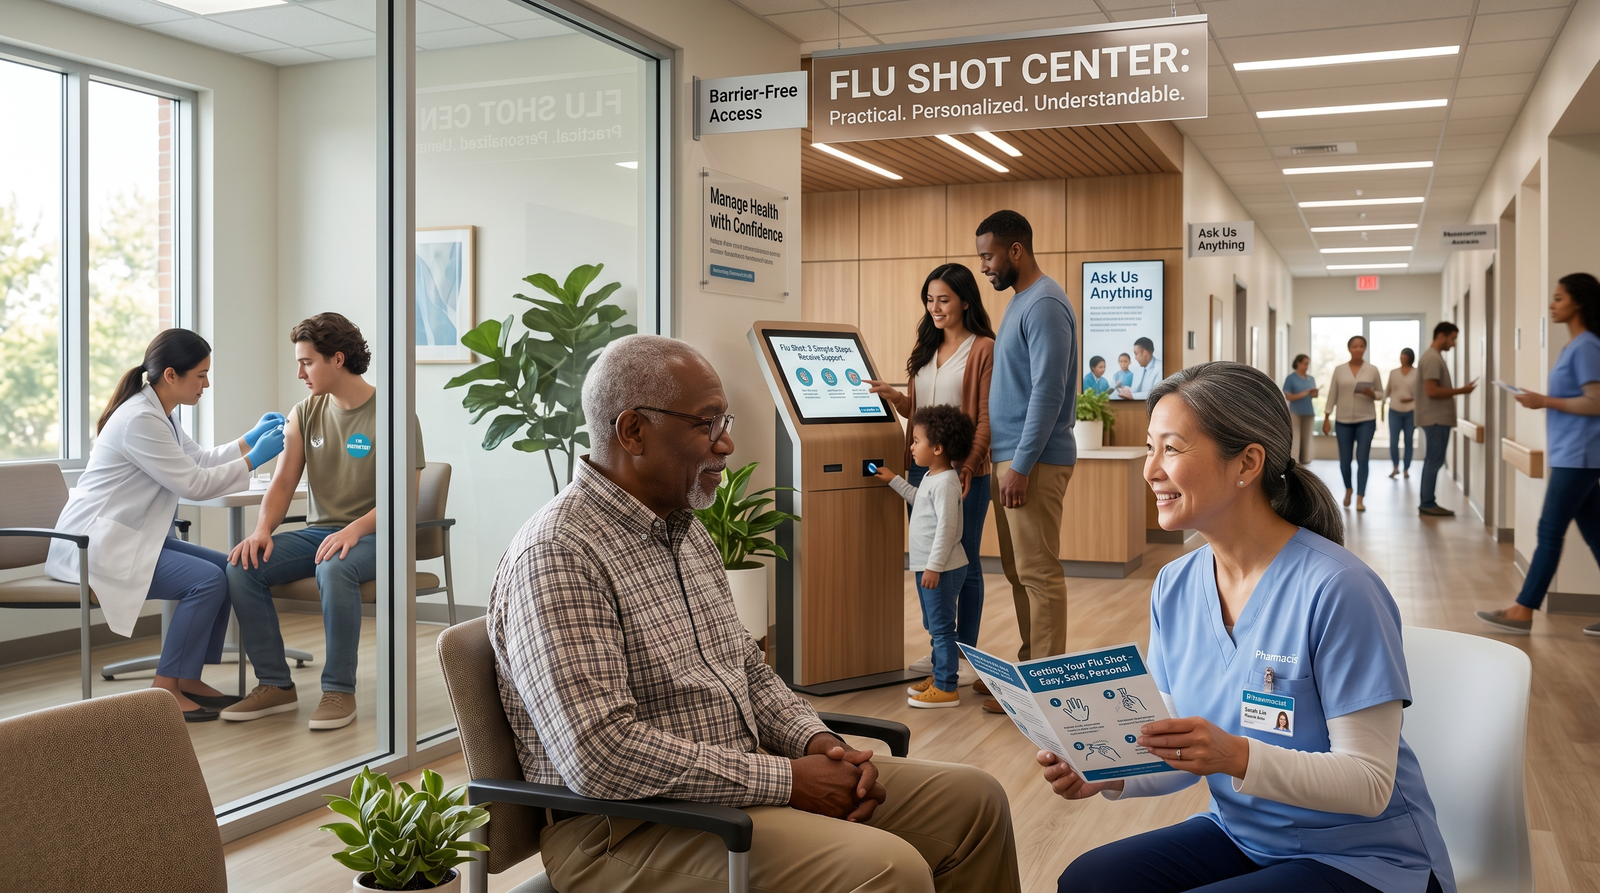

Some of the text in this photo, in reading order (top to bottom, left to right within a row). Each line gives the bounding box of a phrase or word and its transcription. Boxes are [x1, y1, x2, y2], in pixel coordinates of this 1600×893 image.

[830, 42, 1190, 100] FLU SHOT CENTER:
[709, 84, 798, 103] Barrier-Free
[829, 84, 1185, 126] Practical. Personalized. Understandable.
[709, 108, 763, 123] Access
[710, 186, 779, 220] Manage Health
[710, 212, 783, 243] with Confidence
[1198, 227, 1237, 238] Ask Us
[1197, 240, 1245, 253] Anything
[1090, 271, 1139, 284] Ask Us
[1090, 286, 1153, 302] Anything
[780, 344, 791, 352] Flu
[1029, 666, 1064, 677] Getting
[1064, 662, 1086, 671] Your
[1087, 659, 1103, 667] Flu
[1104, 654, 1127, 665] Shot
[1039, 663, 1131, 686] Easy, Safe, Personal
